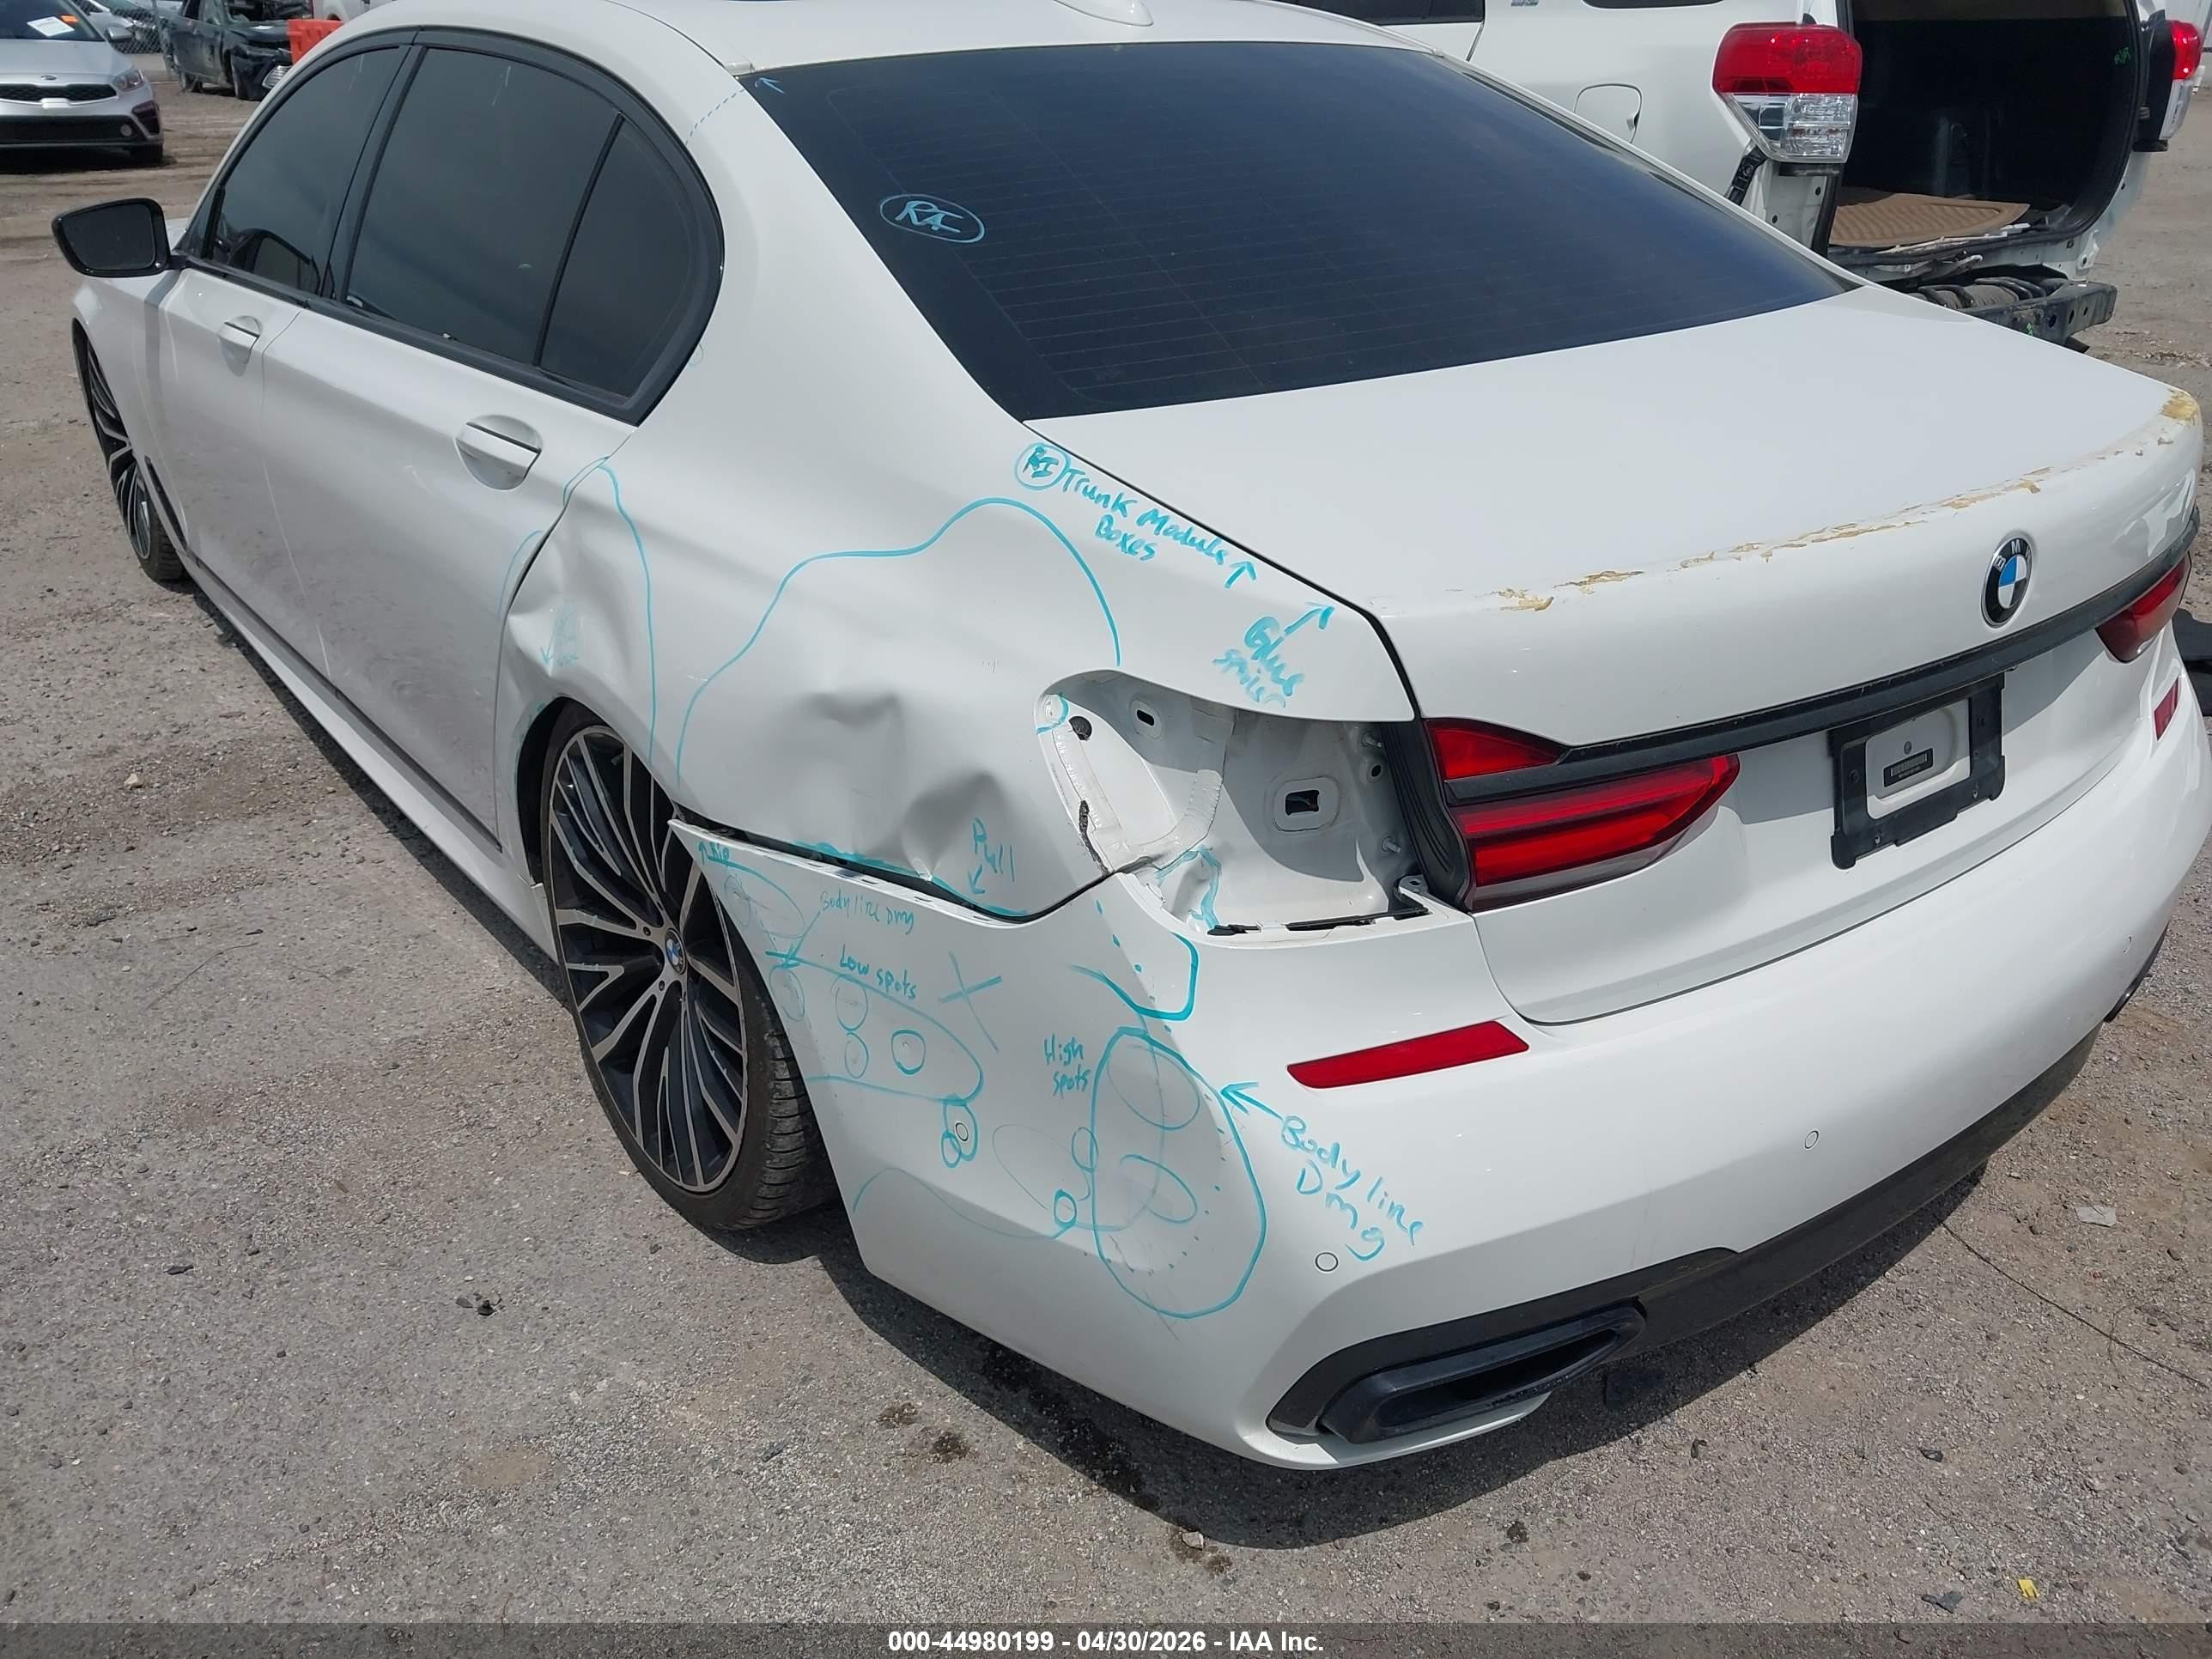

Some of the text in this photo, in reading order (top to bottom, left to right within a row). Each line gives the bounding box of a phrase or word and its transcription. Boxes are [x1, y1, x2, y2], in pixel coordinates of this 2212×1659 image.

[1062, 468, 1139, 518] Trunk
[1095, 514, 1158, 561] Boxes
[1992, 538, 2032, 572] BMW
[839, 944, 870, 975] Low
[1043, 1032, 1084, 1066] High
[1052, 1064, 1091, 1099] spots
[1280, 1115, 1362, 1190] Body
